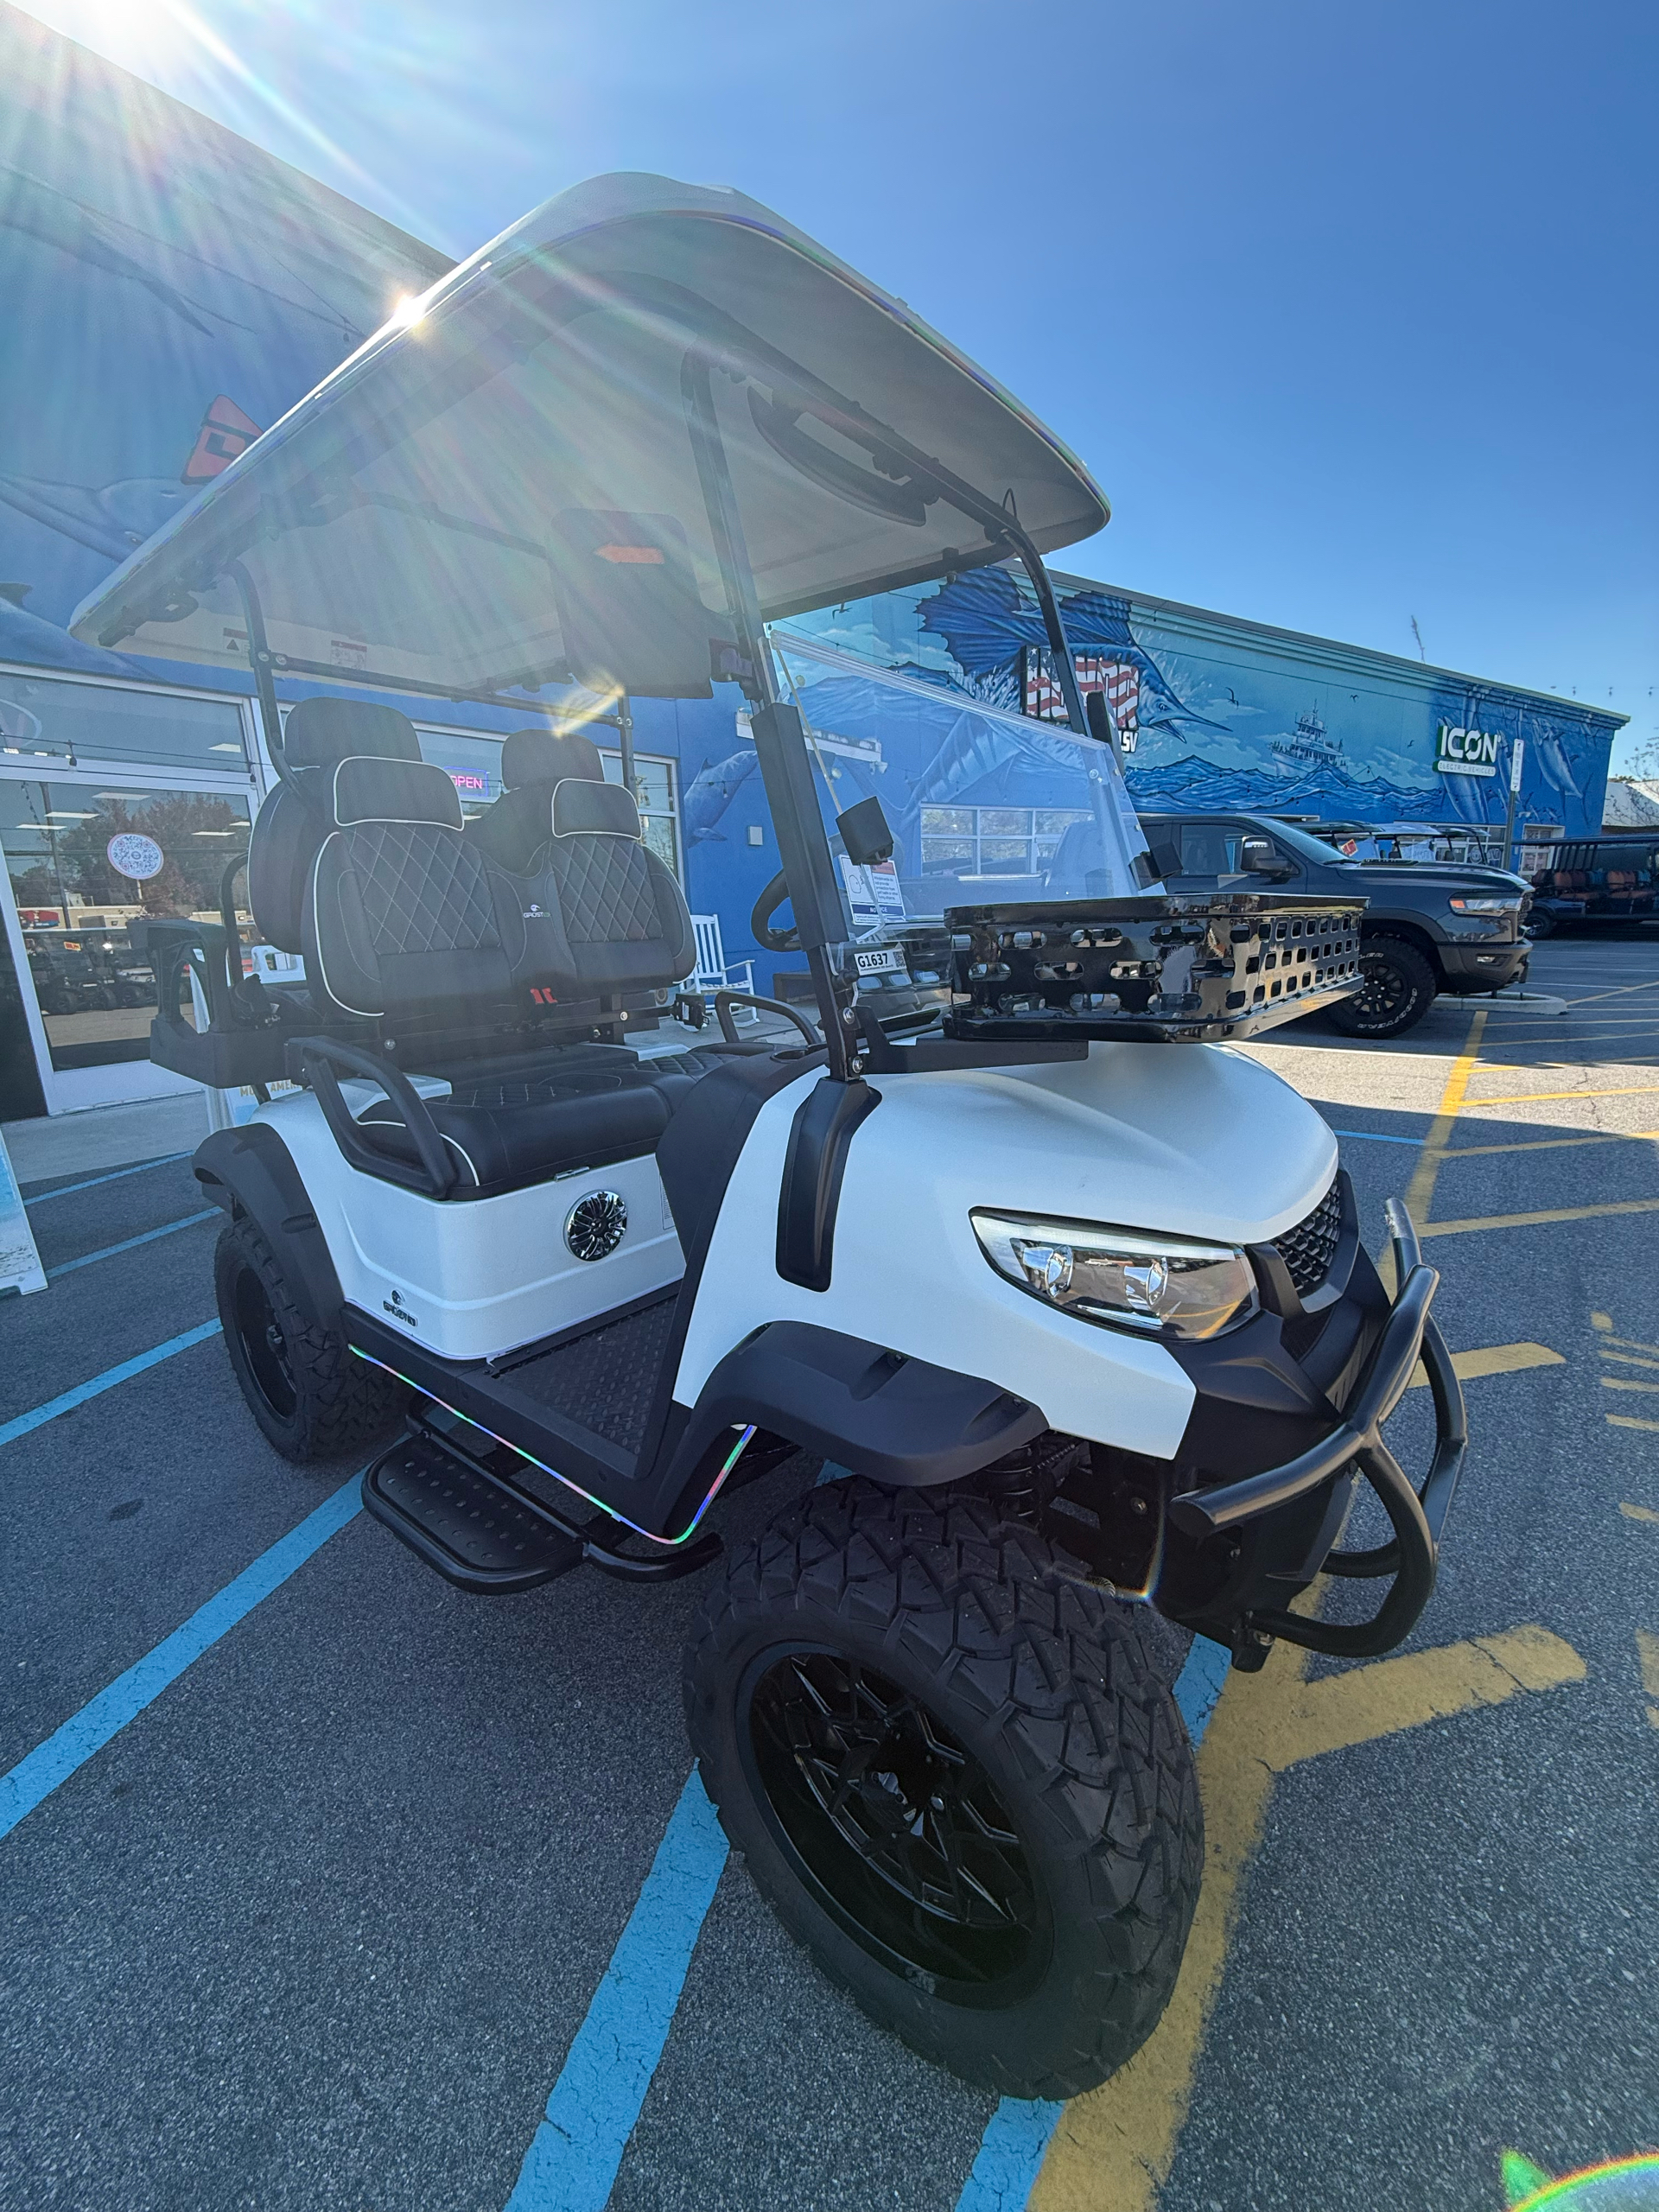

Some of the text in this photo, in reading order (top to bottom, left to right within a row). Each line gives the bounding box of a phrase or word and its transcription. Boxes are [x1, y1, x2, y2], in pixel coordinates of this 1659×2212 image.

[1440, 725, 1498, 763] ICON
[1440, 762, 1494, 775] ELECTRIC VEHICLES
[857, 953, 887, 968] G1637
[1357, 988, 1417, 1029] GOODYEAR
